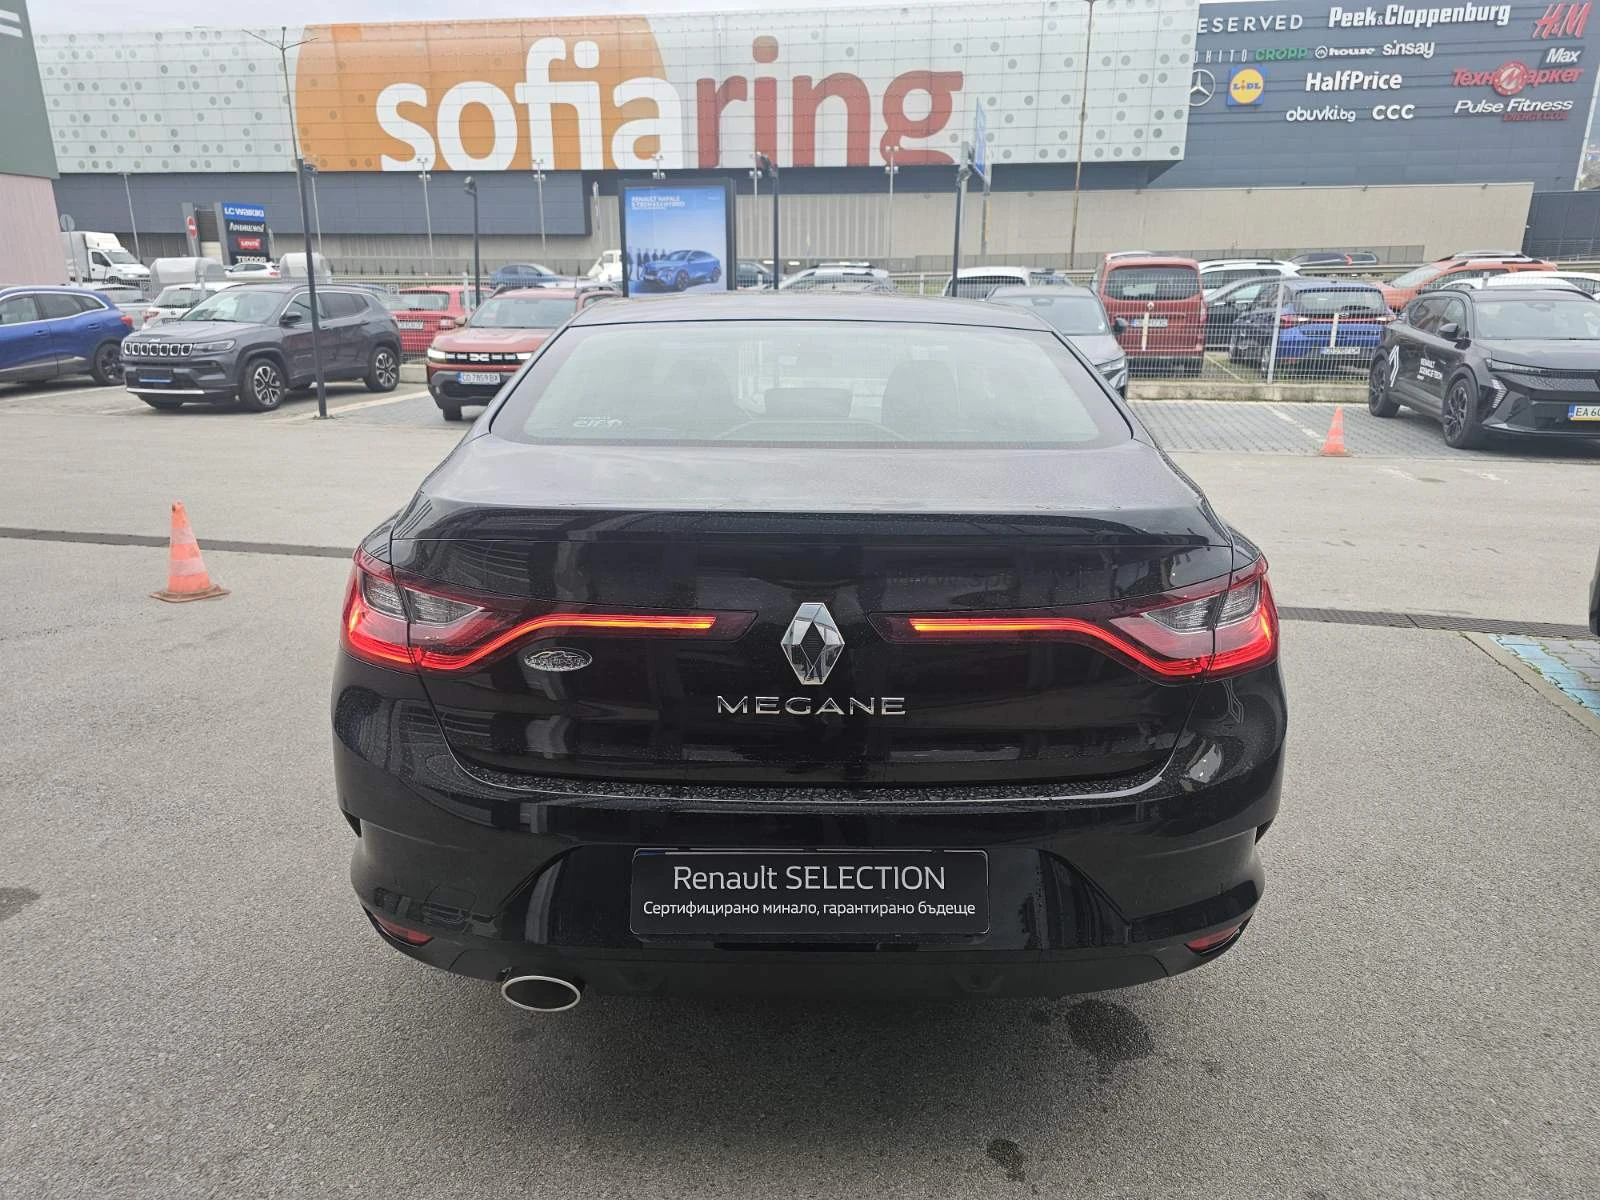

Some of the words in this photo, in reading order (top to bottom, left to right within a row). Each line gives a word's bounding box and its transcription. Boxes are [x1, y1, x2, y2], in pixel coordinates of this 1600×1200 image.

[1198, 14, 1303, 33] ESERVED
[1328, 3, 1511, 28] Peek&Cloppenburg
[1532, 2, 1592, 39] H&M
[1255, 48, 1308, 60] CROPP
[1546, 48, 1581, 64] Max
[1305, 70, 1402, 91] HalfPrice
[1286, 104, 1356, 122] obuvki.bg
[1372, 104, 1415, 120] CCC
[1454, 100, 1504, 114] Pulse
[1507, 98, 1574, 112] Fitness
[1575, 407, 1589, 417] EA
[717, 695, 906, 715] MEGANE
[673, 865, 778, 890] Renault
[785, 865, 945, 890] SELECTION
[643, 901, 759, 917] Сертифицирано
[762, 903, 820, 916] минало,
[823, 903, 915, 917] гарантирано
[918, 901, 976, 916] бъдеще
